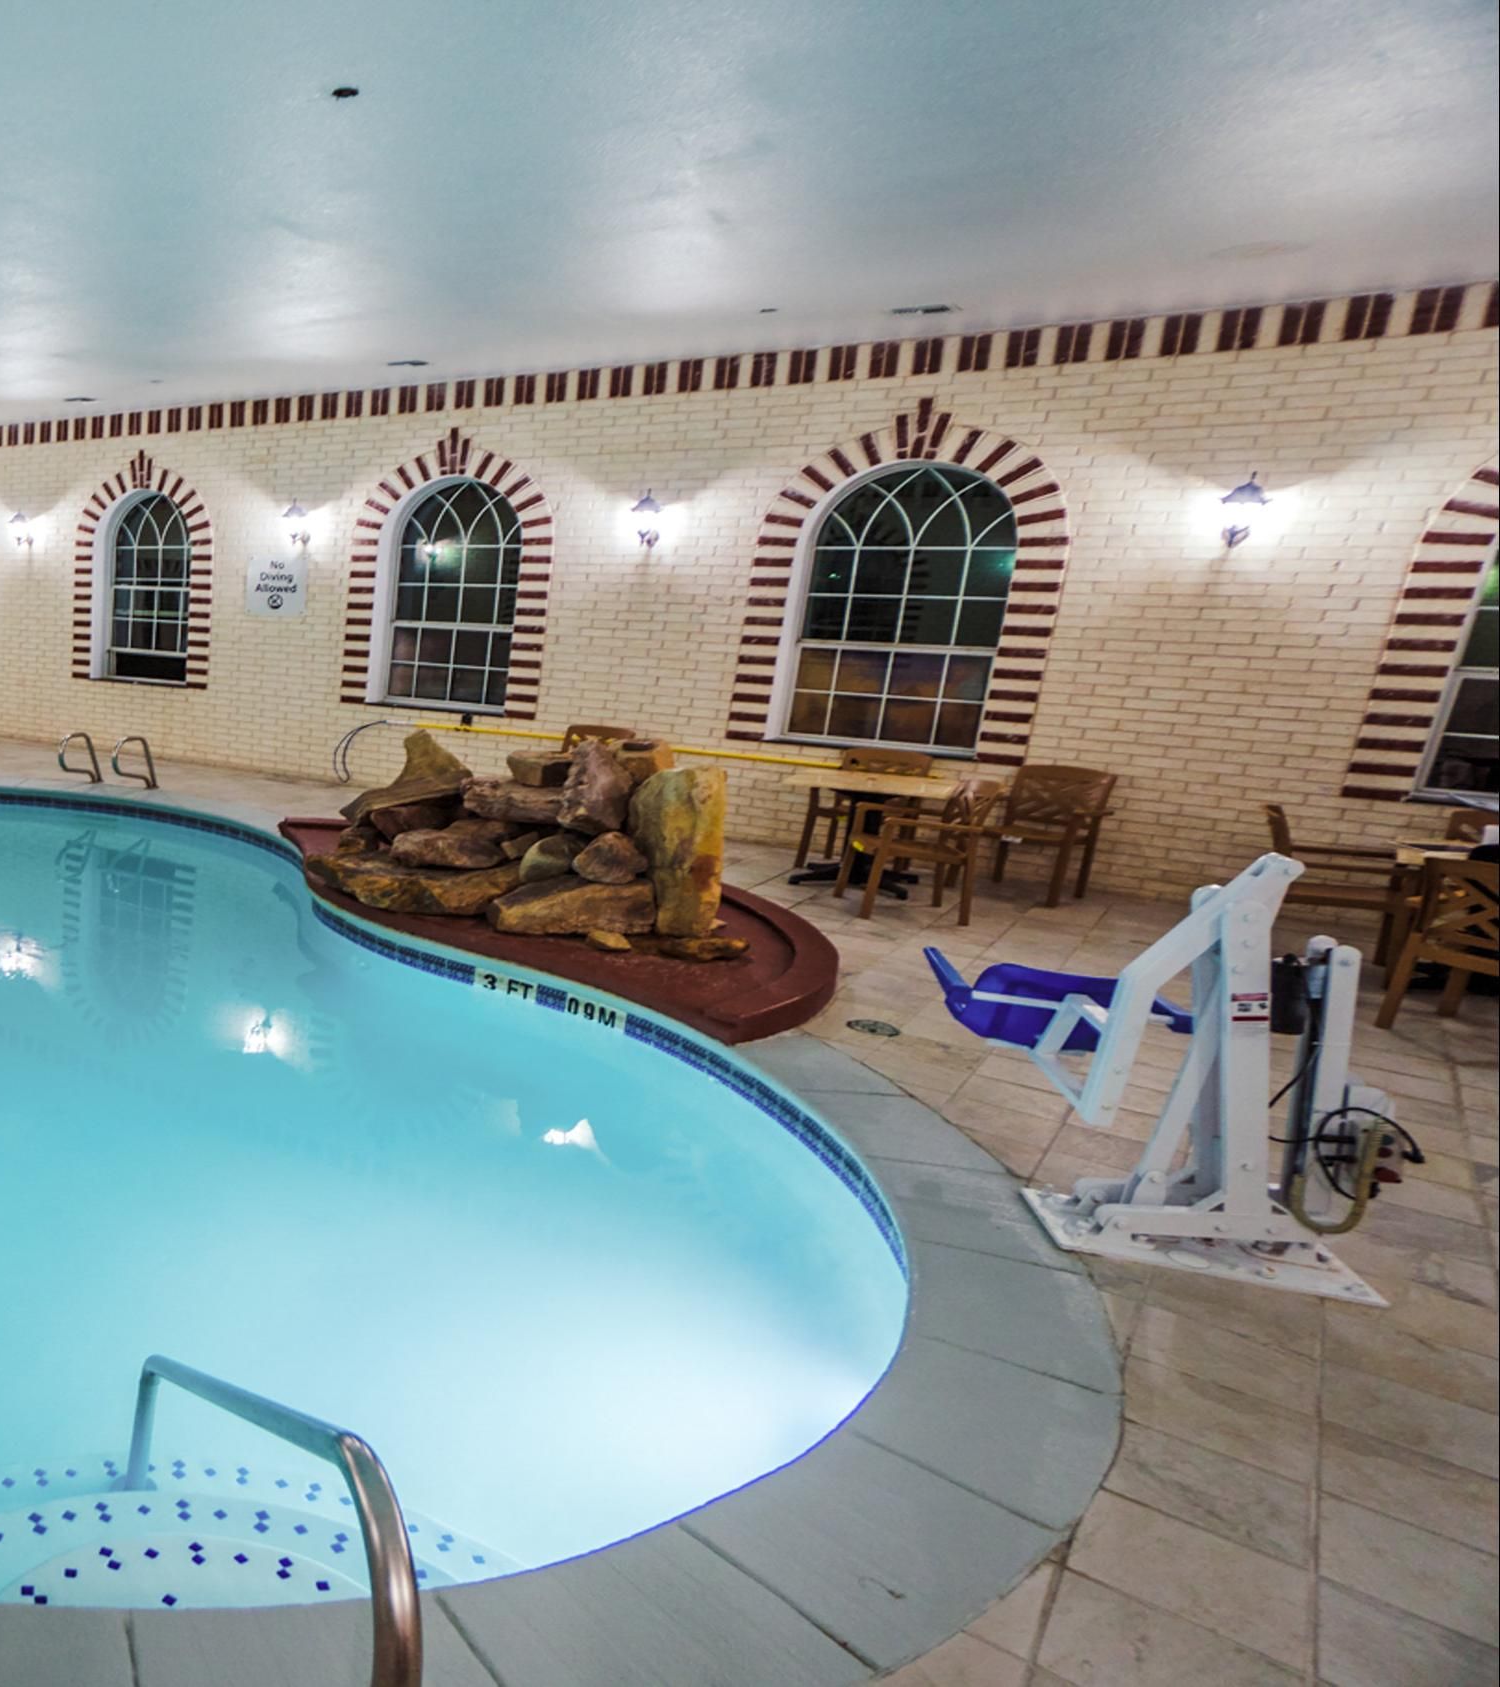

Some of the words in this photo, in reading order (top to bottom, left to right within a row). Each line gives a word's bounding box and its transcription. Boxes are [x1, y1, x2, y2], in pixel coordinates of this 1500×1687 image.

[270, 560, 285, 569] No
[259, 572, 294, 583] Diving
[255, 584, 297, 593] Allowed
[483, 973, 497, 991] 3
[506, 979, 534, 1000] FT
